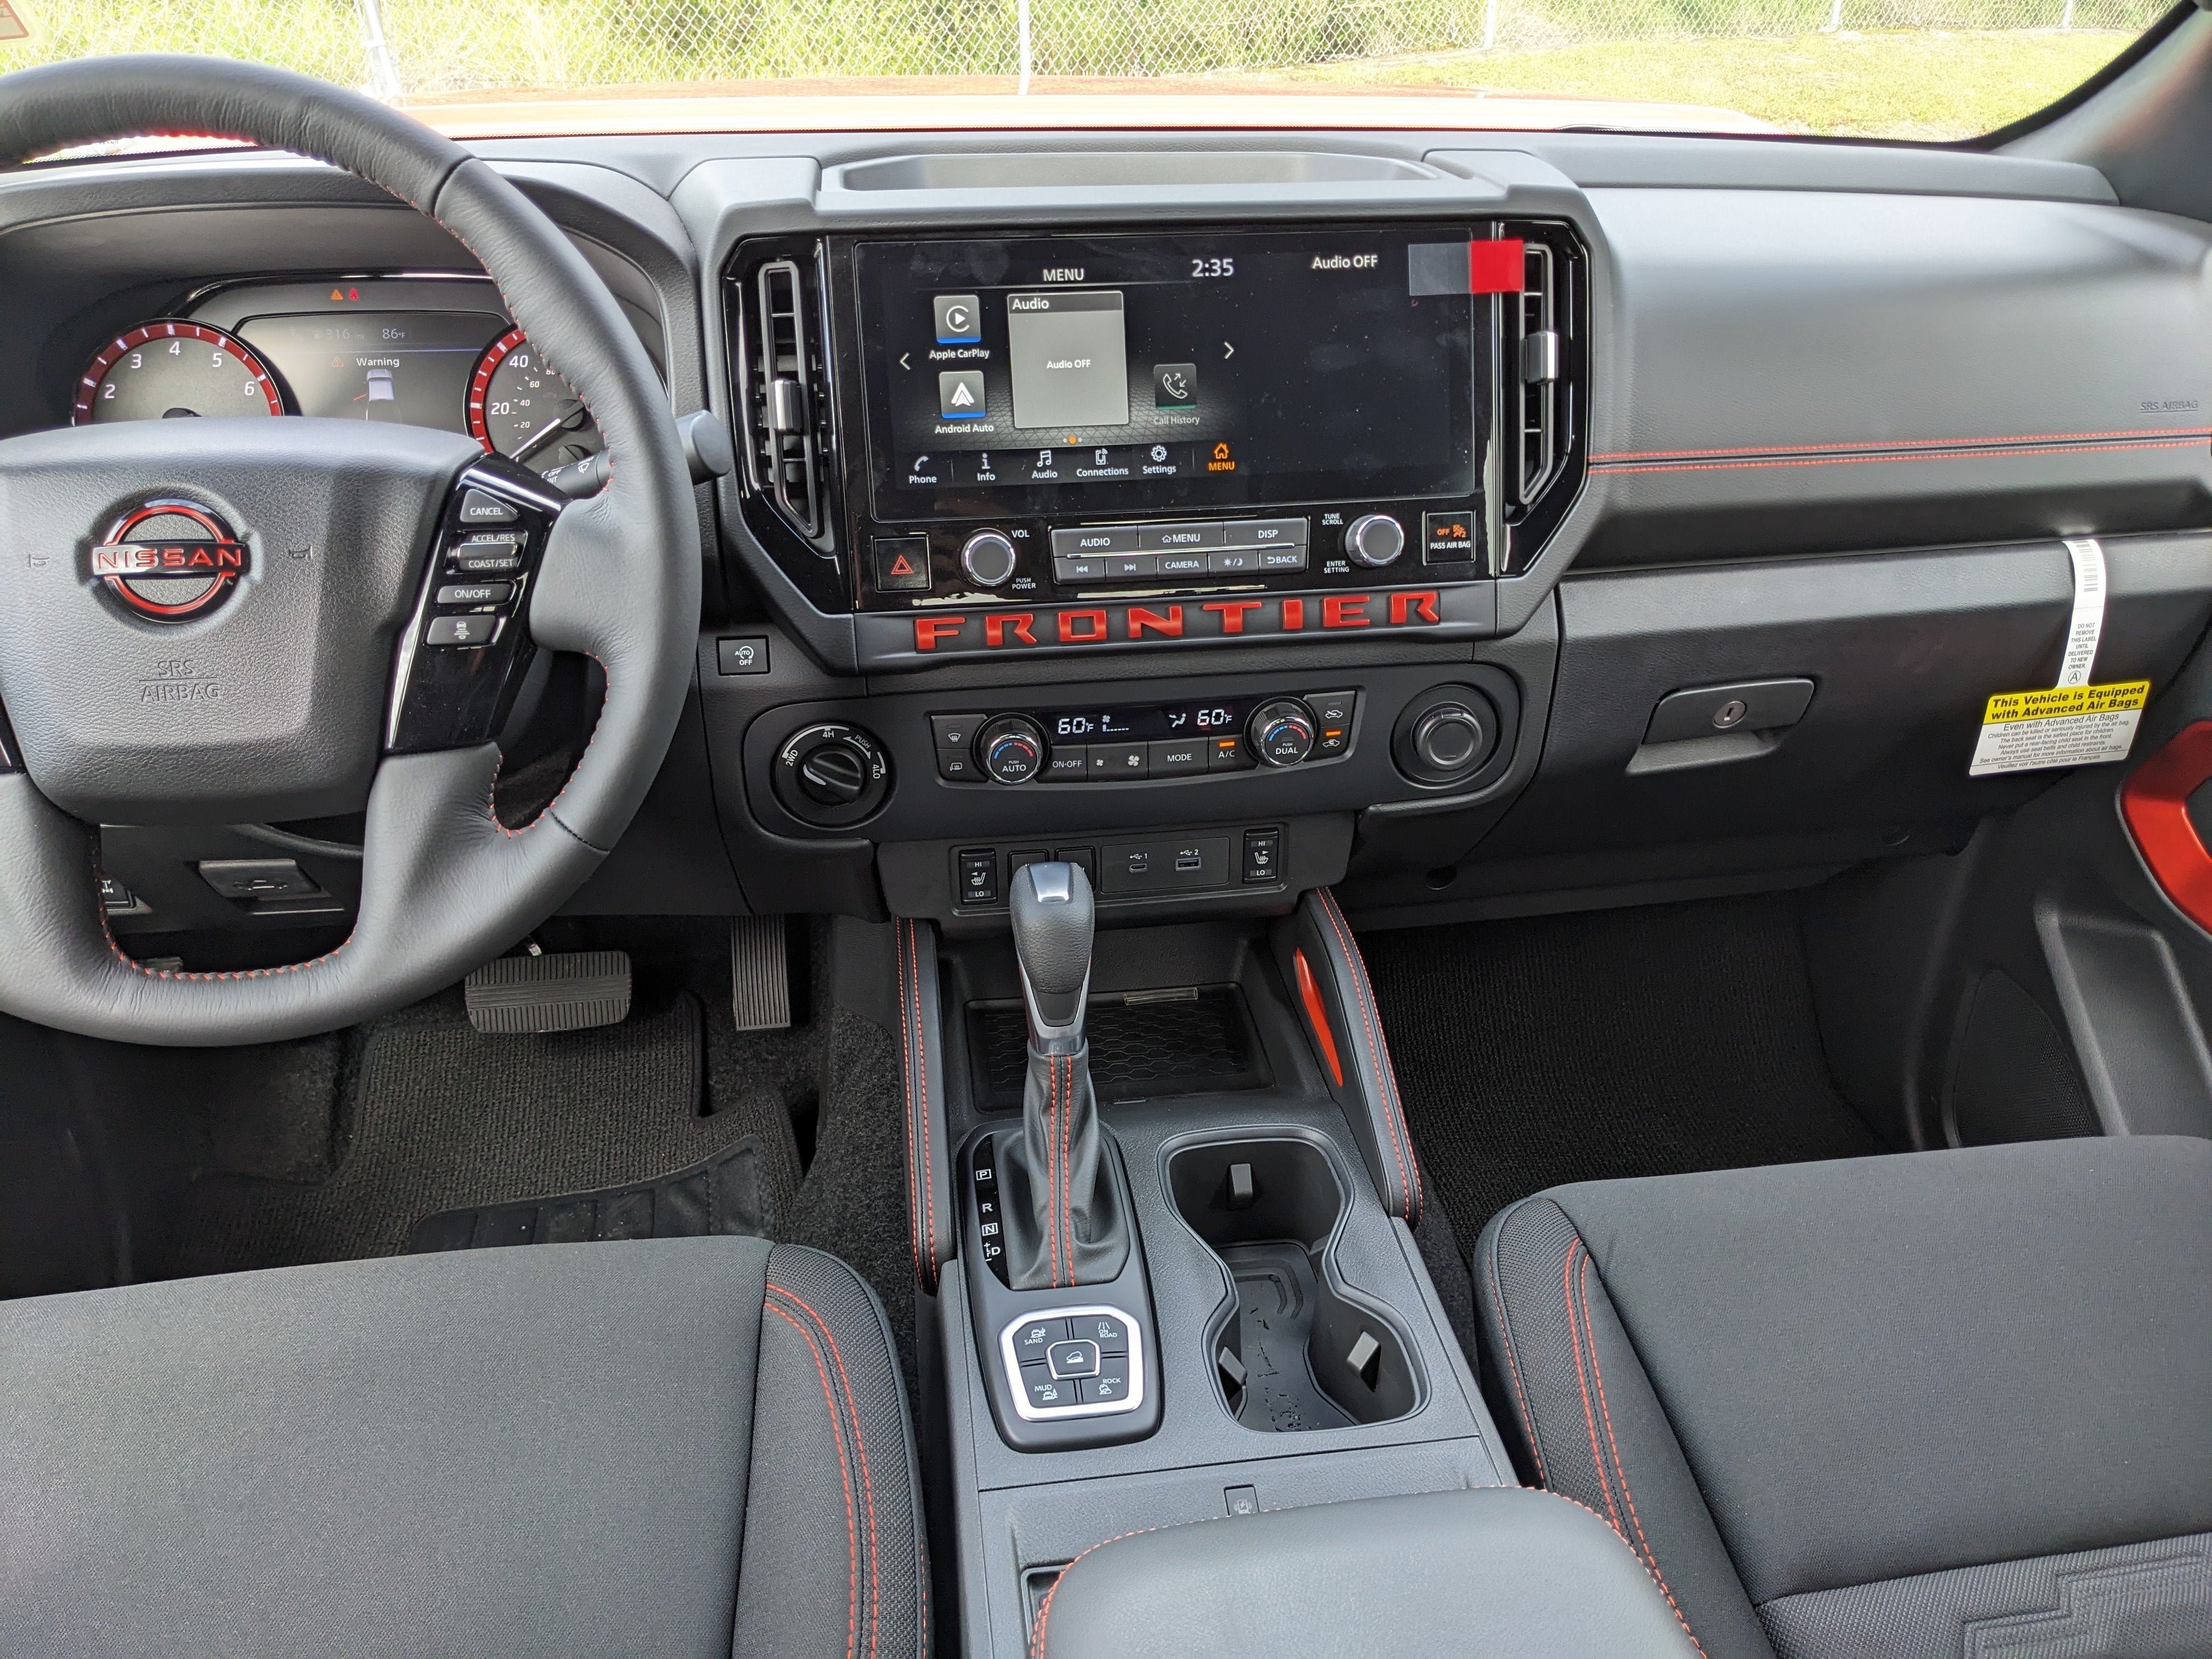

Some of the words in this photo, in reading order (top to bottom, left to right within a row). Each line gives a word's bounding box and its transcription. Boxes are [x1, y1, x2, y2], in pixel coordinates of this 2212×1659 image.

[1192, 258, 1234, 277] 2:35
[1312, 256, 1351, 270] Audio
[1353, 255, 1379, 268] OFF
[1043, 268, 1085, 281] MENU
[1012, 298, 1049, 310] Audio
[169, 342, 180, 356] 4
[929, 350, 956, 359] Apple
[958, 348, 990, 359] CarPlay
[131, 354, 142, 368] 3
[212, 354, 222, 367] 5
[357, 358, 399, 367] Warning
[509, 355, 528, 368] 40
[1046, 360, 1073, 369] Audio
[1074, 359, 1091, 368] OFF
[104, 385, 115, 398] 2
[244, 381, 255, 396] 6
[491, 402, 510, 415] 20
[1154, 415, 1170, 425] Call
[1171, 415, 1200, 426] History
[935, 425, 970, 434] Android
[973, 425, 994, 433] Auto
[1143, 465, 1177, 475] Settings
[1208, 461, 1235, 471] MENU
[977, 473, 996, 481] Info
[1031, 470, 1058, 479] Audio
[1076, 468, 1129, 477] Connections
[909, 475, 937, 484] Phone
[471, 534, 515, 542] ACCEL/RES
[1012, 529, 1030, 538] VOL
[1173, 533, 1201, 543] MENU
[1258, 529, 1279, 539] DISP
[1080, 538, 1110, 547] AUDIO
[98, 548, 241, 567] NISSAN
[1276, 556, 1297, 565] BACK
[469, 558, 514, 568] COAST/SET
[1165, 561, 1199, 569] CAMERA
[1012, 582, 1036, 590] POWER
[455, 589, 491, 598] ON/OFF
[915, 590, 1440, 651] FRONTIER
[157, 661, 195, 678] SRS
[141, 682, 220, 702] AIRBAG
[1993, 697, 2019, 708] This
[2024, 693, 2069, 705] Vehicle
[2073, 691, 2084, 700] is
[2087, 685, 2145, 699] Equipped
[1991, 709, 2018, 720] with
[2022, 702, 2084, 716] Advanced
[2086, 701, 2106, 710] Air
[2108, 698, 2138, 708] Bags
[2027, 720, 2042, 729] with
[2044, 716, 2084, 726] Advanced
[2099, 714, 2119, 722] Bags
[854, 735, 871, 749] PUSH
[1218, 751, 1235, 759] A/C
[1275, 747, 1299, 755] DUAL
[786, 749, 798, 766] 2WD
[1167, 754, 1193, 763] MODE
[872, 764, 881, 779] 4LO
[1002, 764, 1026, 773] AUTO
[983, 1204, 992, 1213] R
